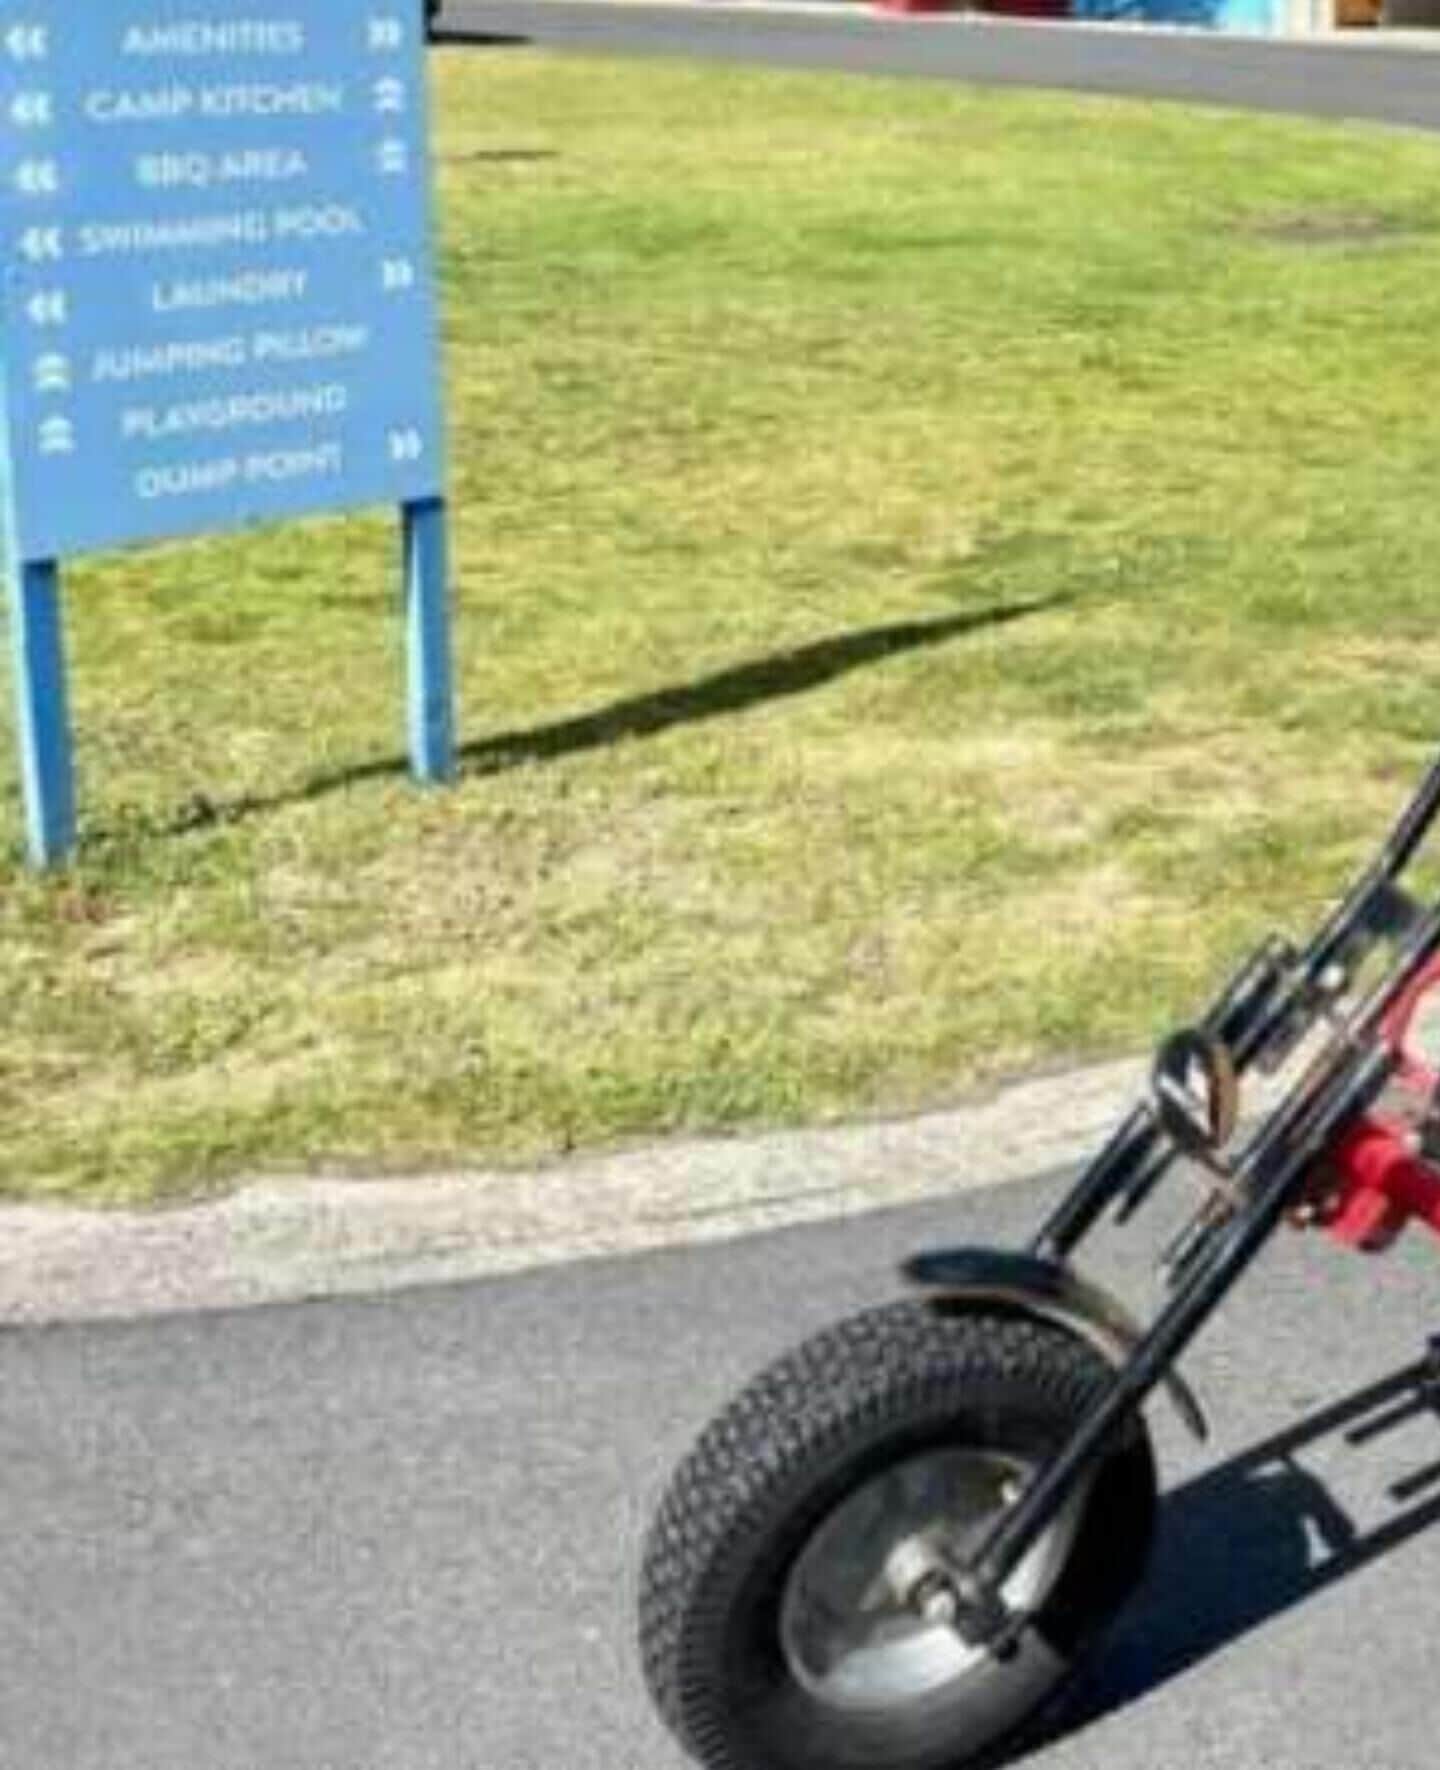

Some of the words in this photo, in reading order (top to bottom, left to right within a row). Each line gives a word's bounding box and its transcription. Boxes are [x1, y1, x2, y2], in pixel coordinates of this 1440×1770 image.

[121, 20, 304, 55] AMENITIES
[85, 86, 193, 121] CAMP
[201, 82, 343, 116] KITCHEN
[135, 151, 209, 189] BBQ
[221, 148, 307, 183] AREA
[78, 208, 268, 253] SWIMMING
[273, 200, 363, 235] POOL
[153, 269, 307, 311] LAUNDRY
[92, 334, 245, 381] JUMPING
[253, 323, 368, 359] PILLOW
[121, 383, 347, 437] PLAYGROUND
[136, 456, 236, 498] DUMP
[244, 441, 342, 482] POINT
